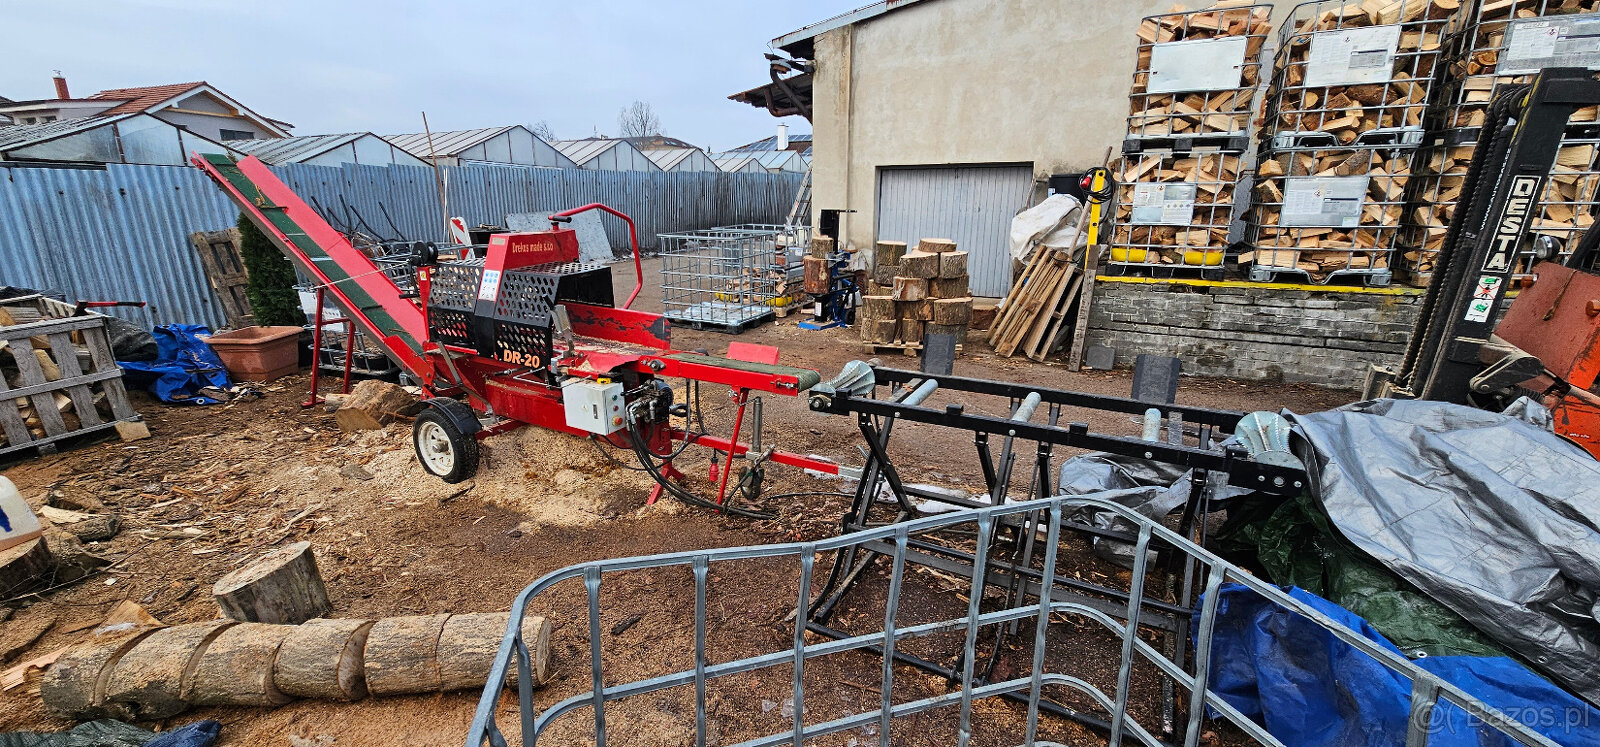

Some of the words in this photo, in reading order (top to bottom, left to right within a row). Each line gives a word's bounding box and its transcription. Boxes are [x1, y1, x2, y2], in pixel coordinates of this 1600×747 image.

[1486, 178, 1535, 270] DESTA
[530, 241, 543, 252] made
[503, 349, 540, 368] DR-20
